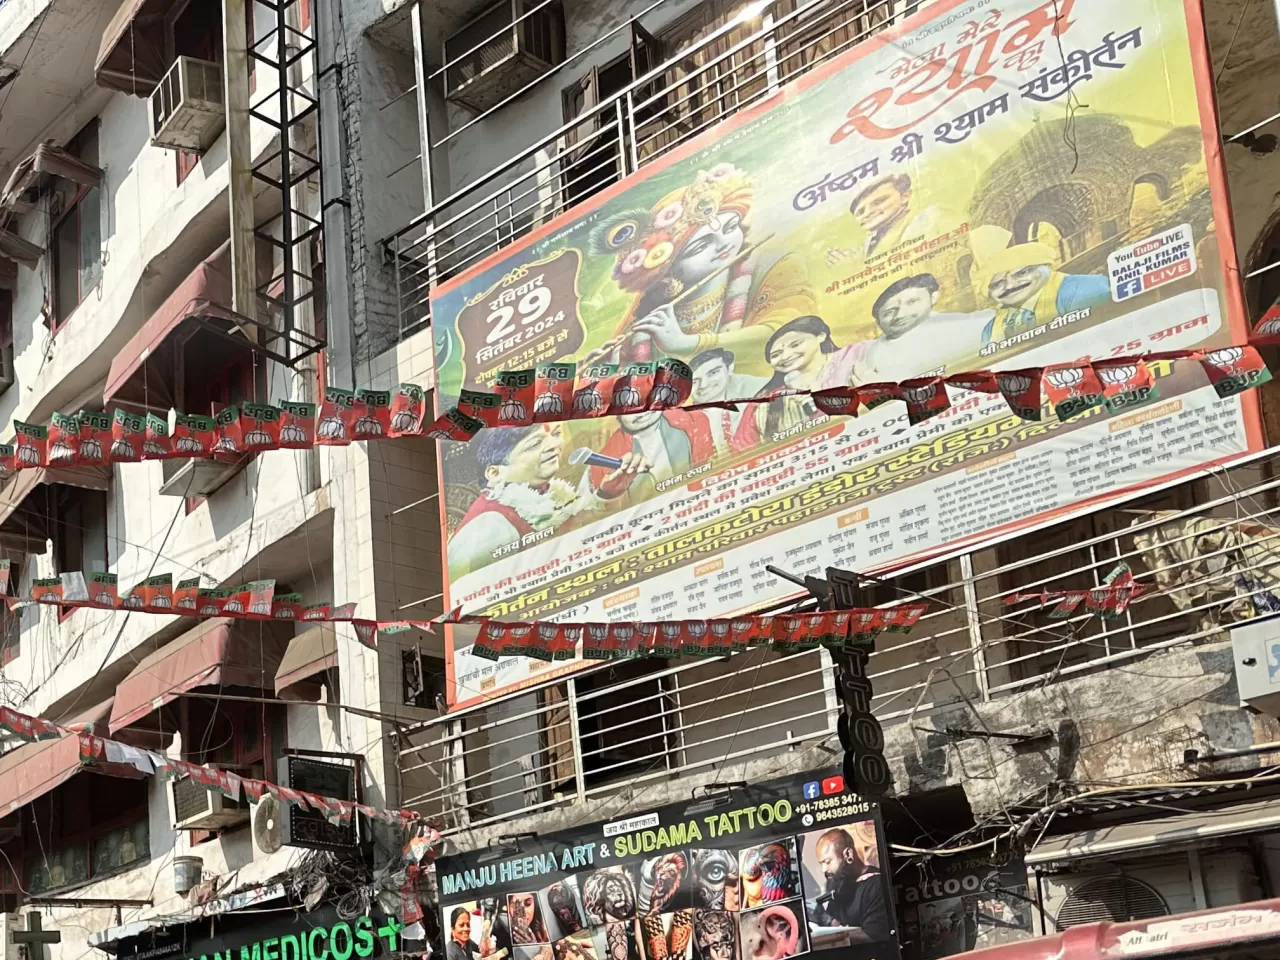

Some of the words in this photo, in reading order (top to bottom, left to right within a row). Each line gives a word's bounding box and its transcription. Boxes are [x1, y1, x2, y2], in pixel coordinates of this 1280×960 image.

[890, 134, 924, 164] श्री
[934, 92, 1010, 144] श्याम
[1018, 26, 1144, 101] संकीर्तन
[825, 281, 839, 295] श्री
[888, 250, 911, 267] सिंह
[952, 222, 970, 238] जी
[1112, 255, 1153, 277] BALAJI
[1155, 241, 1191, 261] FILMS
[1116, 268, 1144, 284] ANIL
[1145, 250, 1189, 273] KUMAR
[1150, 262, 1189, 284] LIVE
[489, 272, 545, 311] रविवार
[486, 286, 552, 344] 29
[979, 341, 997, 358] श्री
[999, 321, 1047, 350] भगवान
[1049, 306, 1091, 331] दीक्षित
[475, 332, 525, 366] सितंबर
[526, 310, 566, 339] 2024
[506, 349, 535, 371] 12:15
[556, 328, 570, 346] से
[1111, 340, 1142, 357] 25
[1111, 386, 1151, 409] BJP
[1220, 369, 1262, 393] BJP
[630, 509, 665, 530] कूपन
[668, 490, 713, 513] मिलने
[720, 478, 738, 492] का
[743, 459, 784, 483] समय
[835, 432, 851, 448] से
[701, 463, 753, 490] विशेष
[755, 430, 832, 469] आकर्षण
[770, 479, 798, 497] कर
[494, 575, 514, 591] की
[595, 529, 634, 550] ग्राम
[660, 514, 671, 526] 2
[675, 502, 709, 521] चांदी
[717, 487, 738, 504] की
[833, 433, 881, 460] ग्राम
[479, 585, 551, 619] कीर्तन
[553, 556, 624, 592] स्थल
[644, 496, 793, 560] तालकटोरा
[491, 538, 520, 559] संजय
[521, 525, 555, 548] मित्तल
[614, 569, 638, 587] श्री
[642, 550, 694, 575] श्याम
[698, 519, 772, 554] परिवार
[606, 824, 618, 836] जय
[619, 821, 628, 833] श्री
[629, 816, 657, 829] महाकाल
[815, 804, 870, 823] 9643528015
[442, 864, 497, 895] MANJU
[500, 852, 559, 882] HEENA
[561, 843, 596, 871] ART
[599, 843, 611, 860] &
[614, 820, 702, 858] SUDAMA
[704, 799, 793, 838] TATTOO
